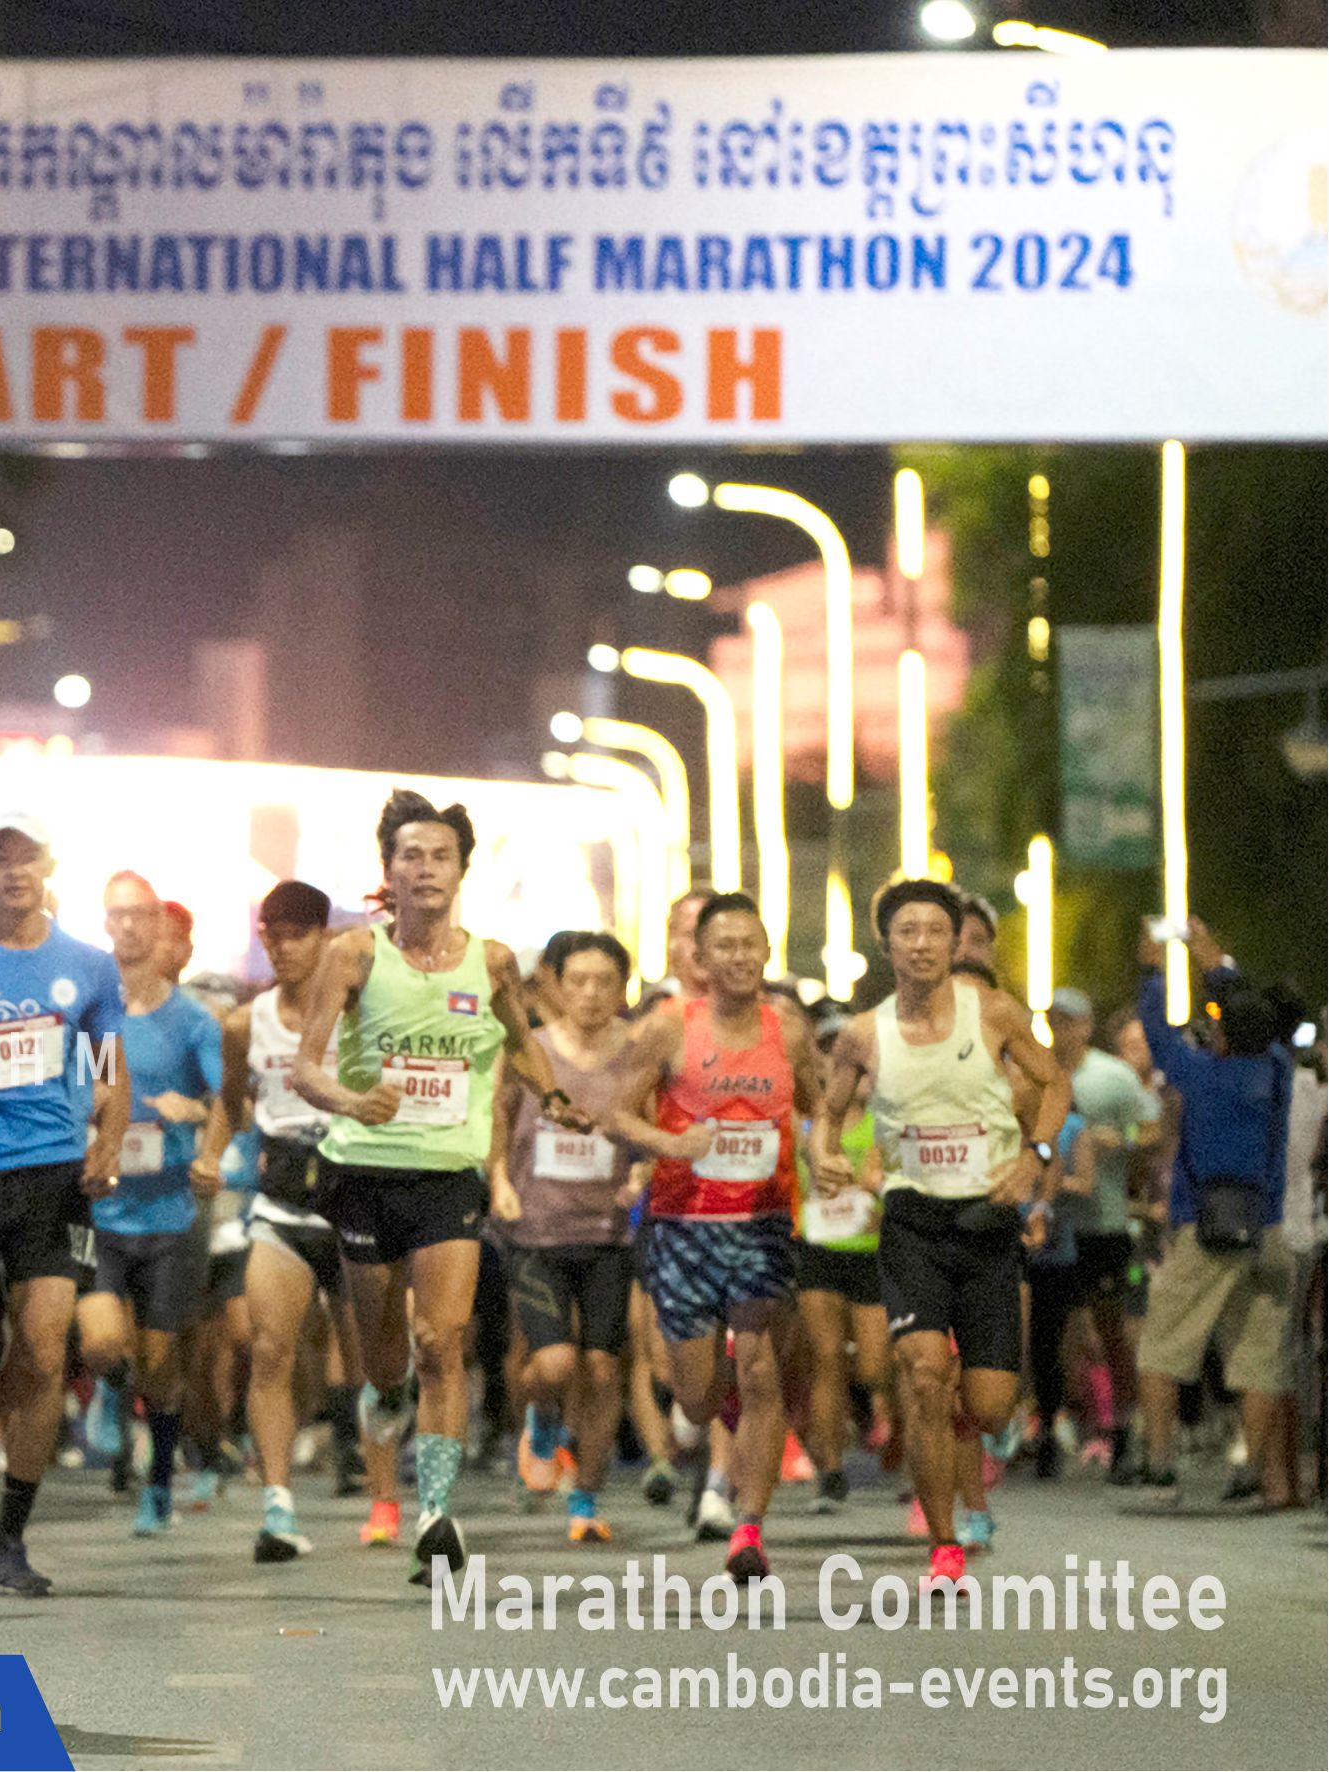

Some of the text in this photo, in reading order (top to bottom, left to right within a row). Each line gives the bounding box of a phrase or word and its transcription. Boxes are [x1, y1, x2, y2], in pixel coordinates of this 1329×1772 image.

[426, 234, 572, 293] HALF
[593, 233, 948, 291] MARATHON
[970, 232, 1135, 291] 2024
[230, 326, 287, 424] /
[326, 324, 784, 424] FINISH
[405, 1076, 452, 1099] 0164
[703, 1075, 774, 1094] JAPAN
[919, 1144, 969, 1165] 0032
